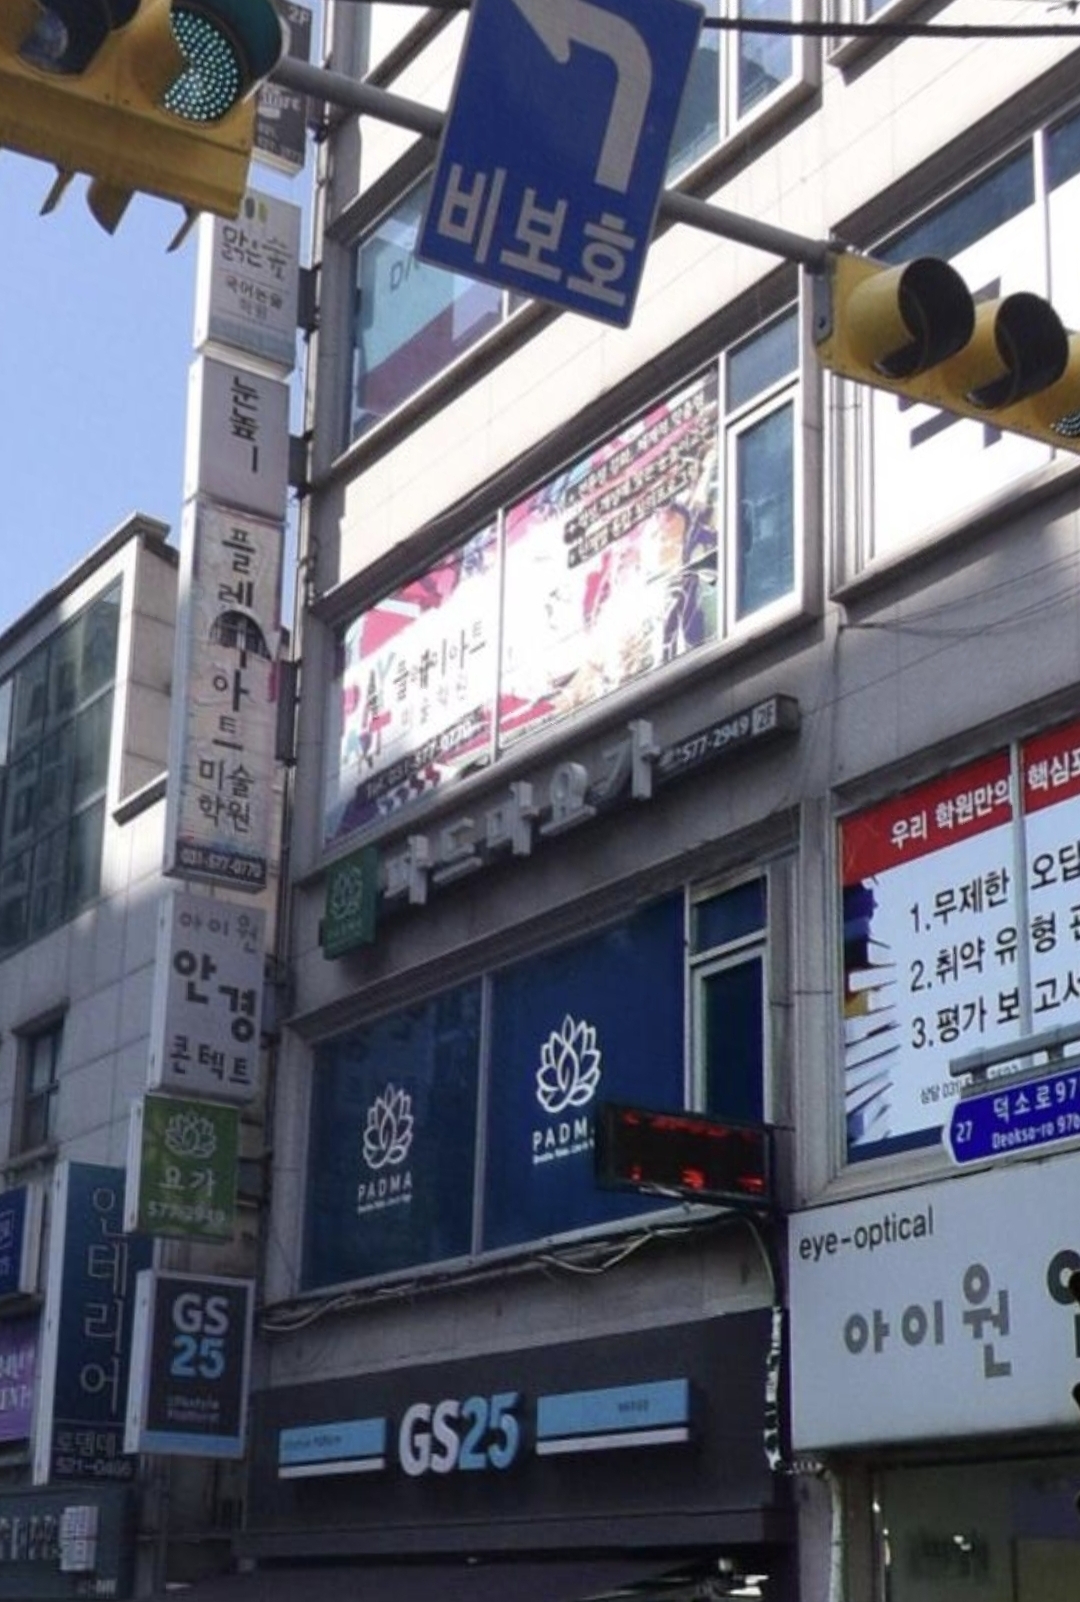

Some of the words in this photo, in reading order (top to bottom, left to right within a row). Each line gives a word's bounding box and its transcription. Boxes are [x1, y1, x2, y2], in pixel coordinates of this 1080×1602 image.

[437, 164, 636, 308] 비보호
[229, 376, 260, 474] 눈높이
[200, 763, 255, 799] 미술
[198, 793, 251, 834] 학원
[891, 811, 928, 850] 우리
[935, 774, 1013, 829] 학원만의
[178, 912, 259, 954] 아이원
[173, 950, 256, 1044] 안경
[533, 1116, 595, 1151] PADM
[956, 1120, 974, 1143] 27
[992, 1121, 1055, 1149] Deokso-ro
[158, 1165, 217, 1197] 요가
[358, 1171, 413, 1200] PADMA
[799, 1204, 934, 1262] eye-optical
[172, 1291, 230, 1335] GS
[844, 1263, 1012, 1379] 아이원
[170, 1333, 226, 1380] 25
[400, 1391, 520, 1477] GS25
